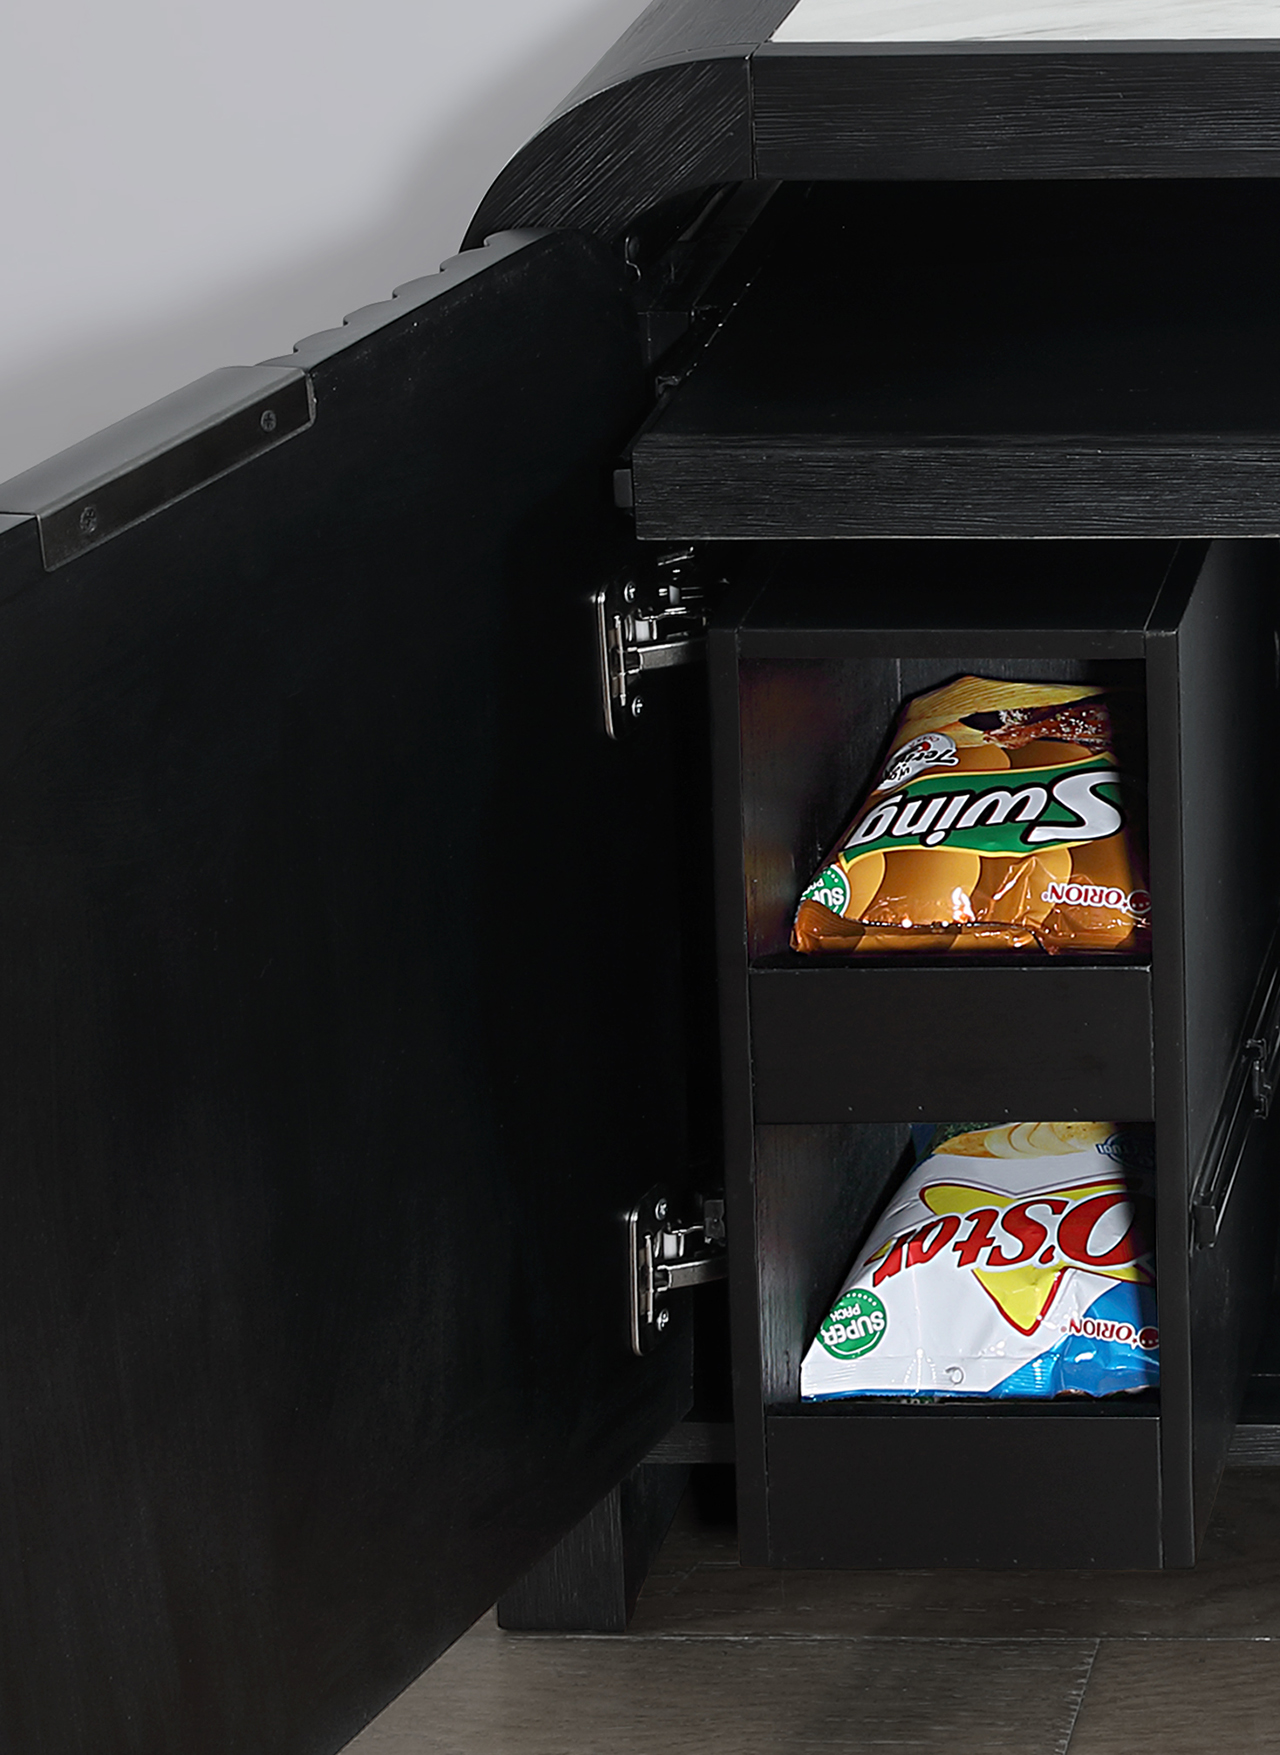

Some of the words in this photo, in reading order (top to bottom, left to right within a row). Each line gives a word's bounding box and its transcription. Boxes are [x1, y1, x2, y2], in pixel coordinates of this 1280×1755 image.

[844, 771, 1122, 850] Swing
[1049, 884, 1123, 906] ORION
[829, 1303, 862, 1322] PACK
[820, 1310, 885, 1346] SUPER
[1068, 1318, 1134, 1342] ORION
